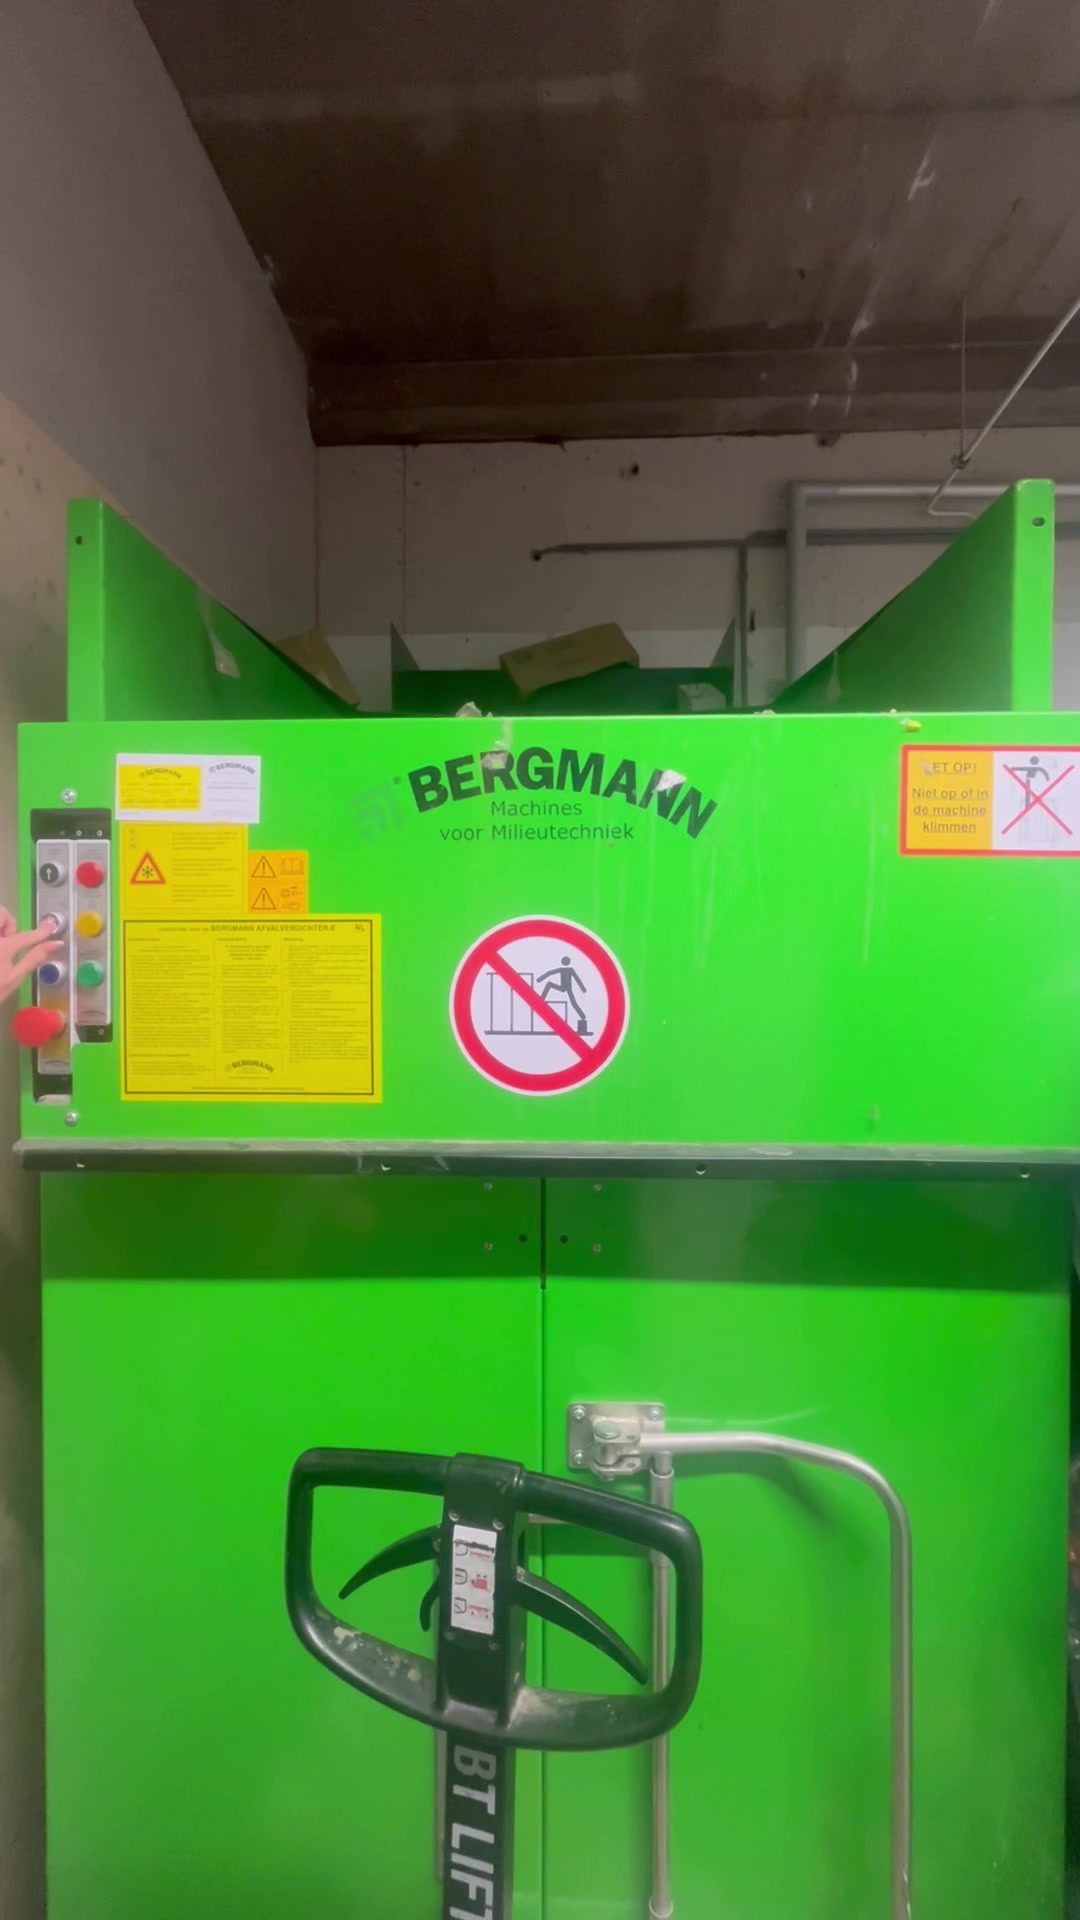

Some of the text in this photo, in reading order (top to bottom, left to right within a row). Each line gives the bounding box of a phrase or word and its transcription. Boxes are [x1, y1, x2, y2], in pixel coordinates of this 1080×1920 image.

[953, 762, 976, 773] OP!
[408, 747, 718, 839] BERGMANN
[912, 788, 988, 801] Niet op of in
[491, 800, 583, 816] Machines
[913, 805, 986, 816] de machine
[440, 823, 635, 841] voor Milieutechniek
[923, 821, 976, 833] klimmen
[452, 1745, 497, 1815] BT
